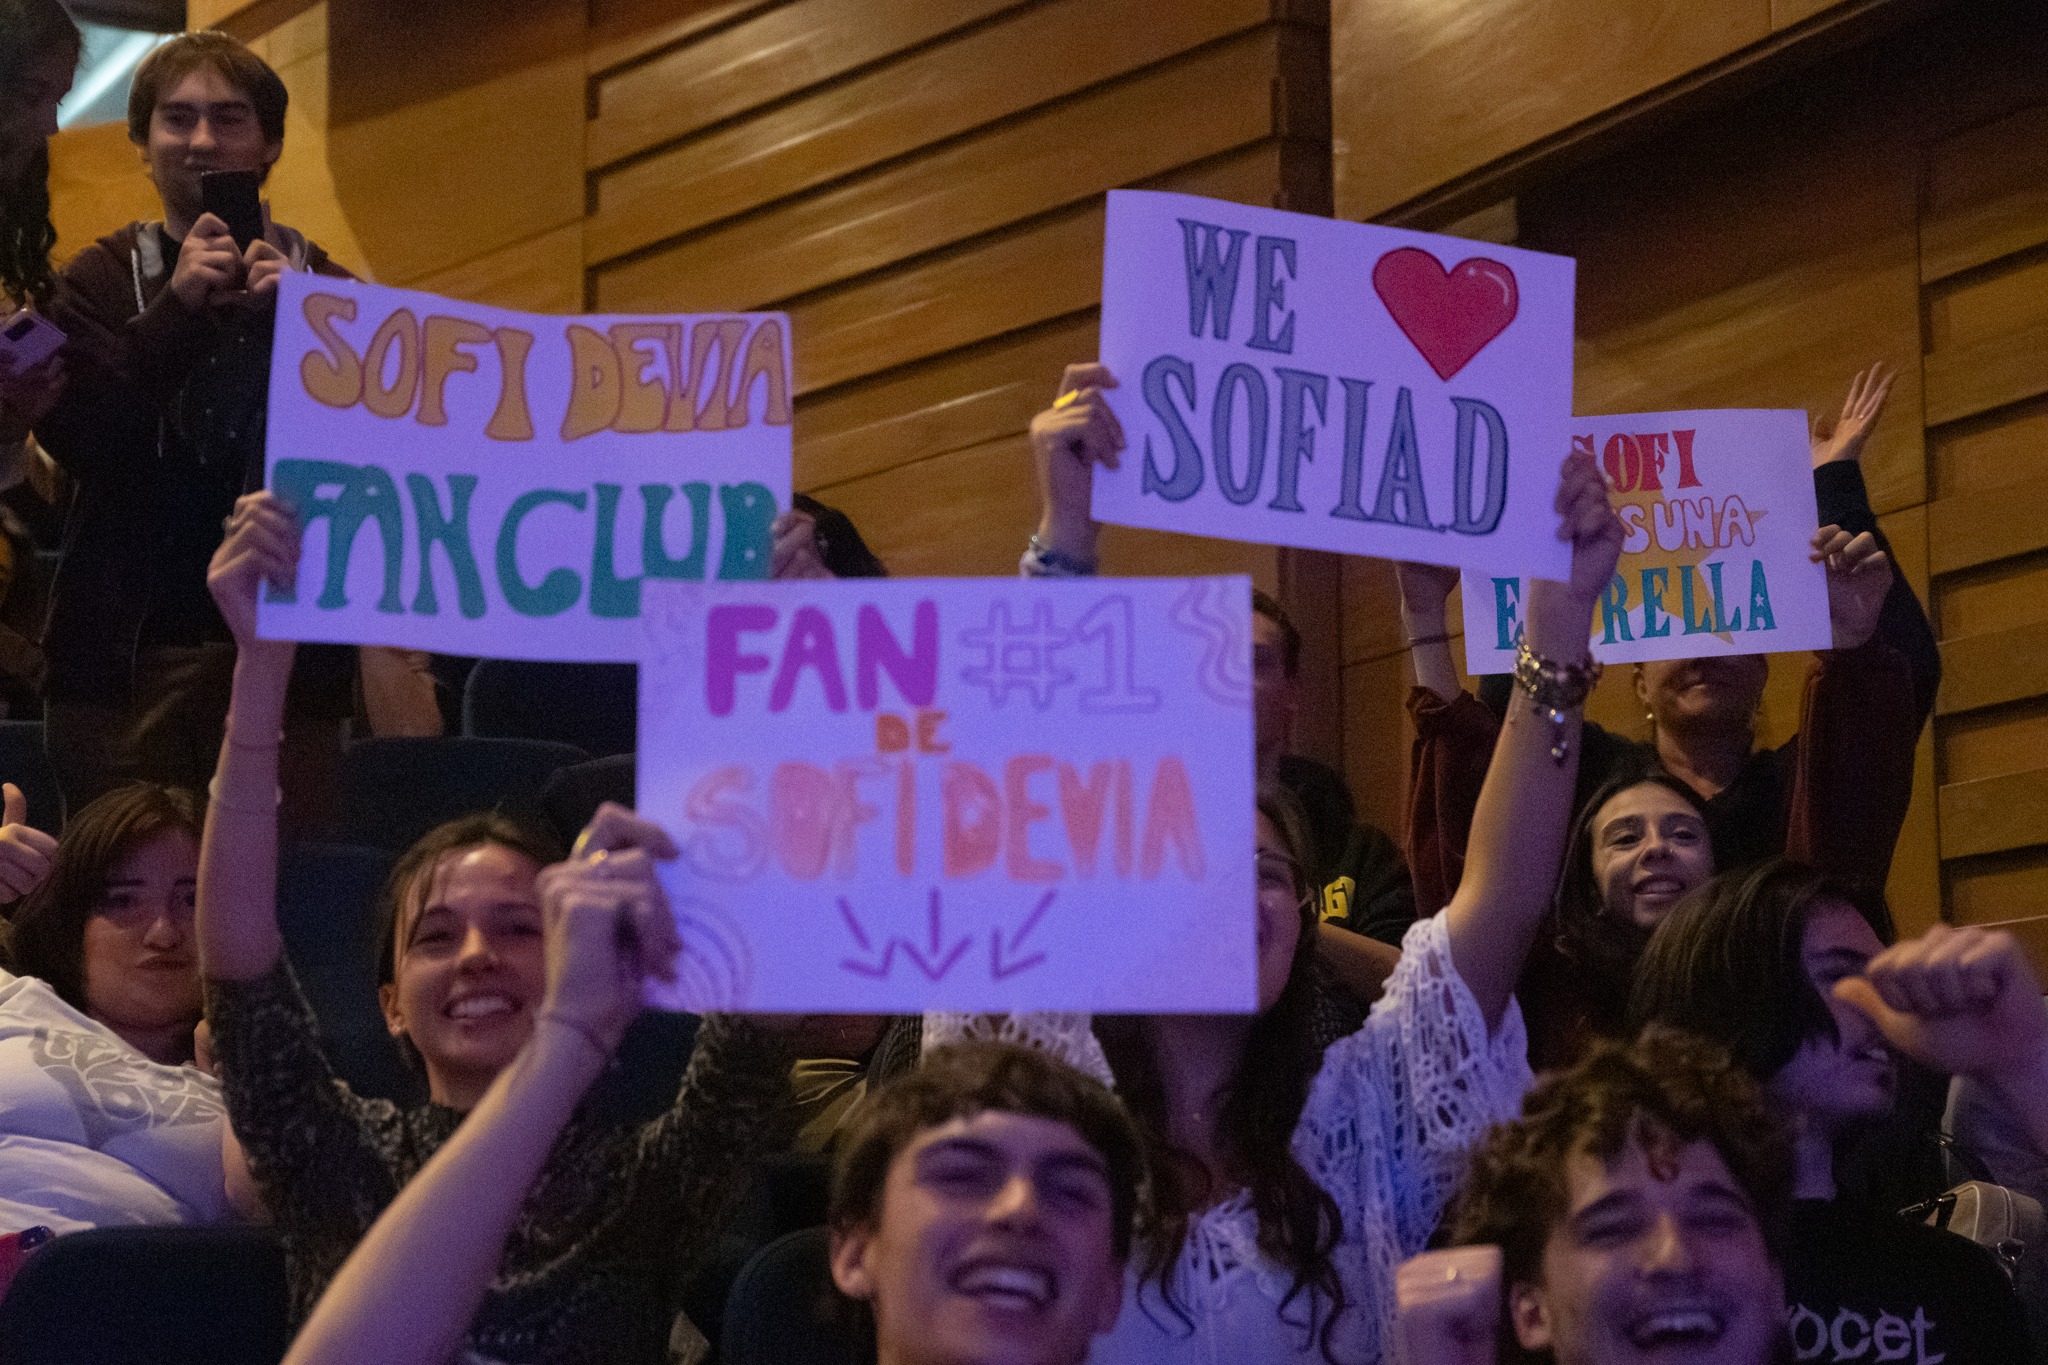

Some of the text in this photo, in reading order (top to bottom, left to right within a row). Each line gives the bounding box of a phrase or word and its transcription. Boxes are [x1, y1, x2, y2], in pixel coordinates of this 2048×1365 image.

[1176, 217, 1297, 355] WE
[300, 292, 793, 443] SOFI DEVIA
[264, 458, 778, 620] FAN CLUB
[1491, 558, 1778, 651] ERELLA
[705, 594, 1164, 717] FAN #1
[875, 711, 950, 755] DE
[685, 755, 1205, 886] SOFI DEVIA
